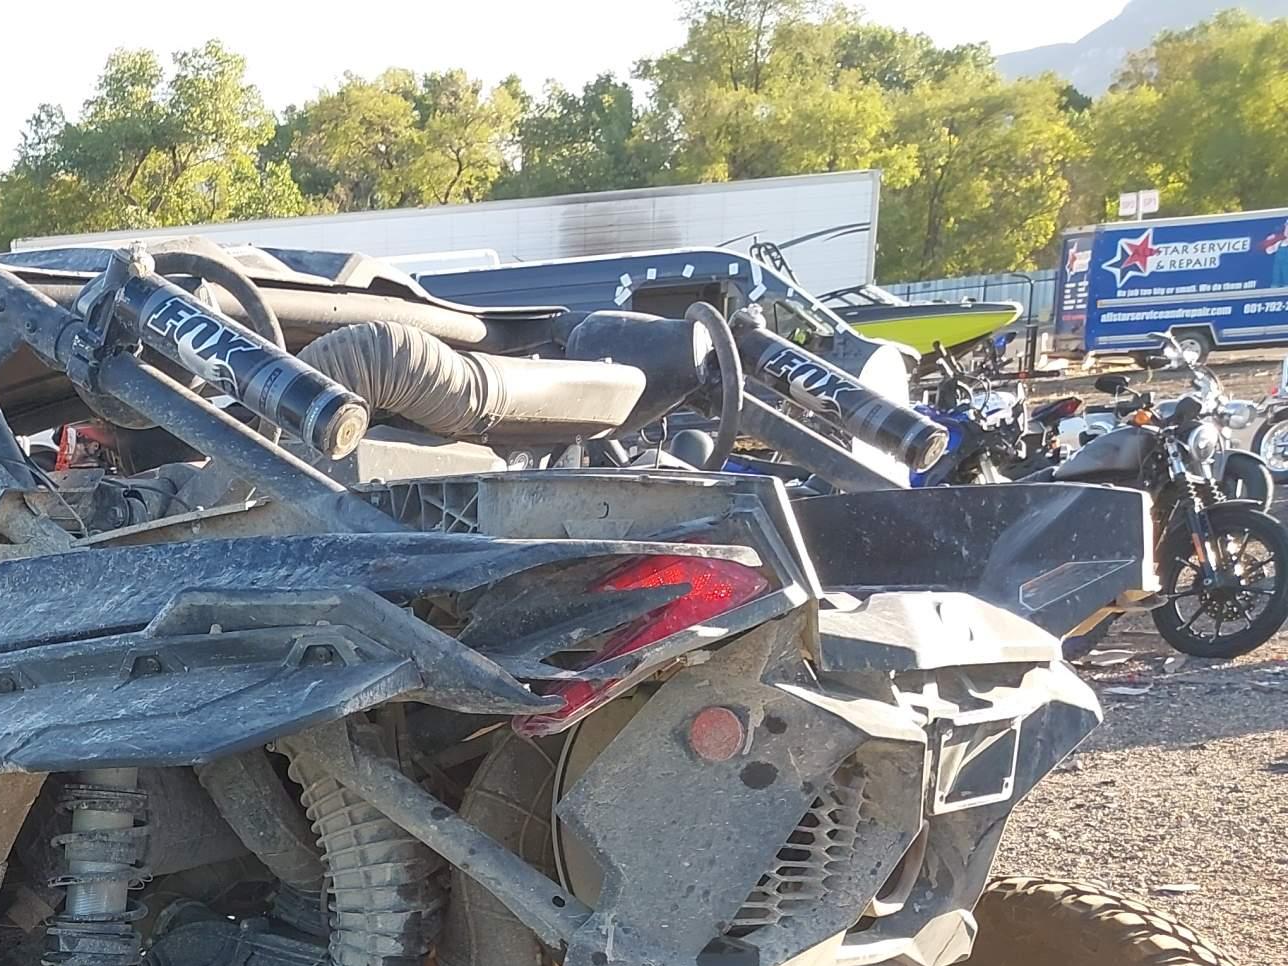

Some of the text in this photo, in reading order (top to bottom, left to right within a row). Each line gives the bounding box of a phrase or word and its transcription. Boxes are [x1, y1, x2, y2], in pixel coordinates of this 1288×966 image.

[1154, 239, 1249, 257] STAR SERVICE
[1155, 256, 1218, 271] & REPAIR
[1212, 283, 1223, 292] do
[1223, 282, 1242, 291] them
[147, 296, 262, 368] FOX
[763, 348, 863, 402] FOX
